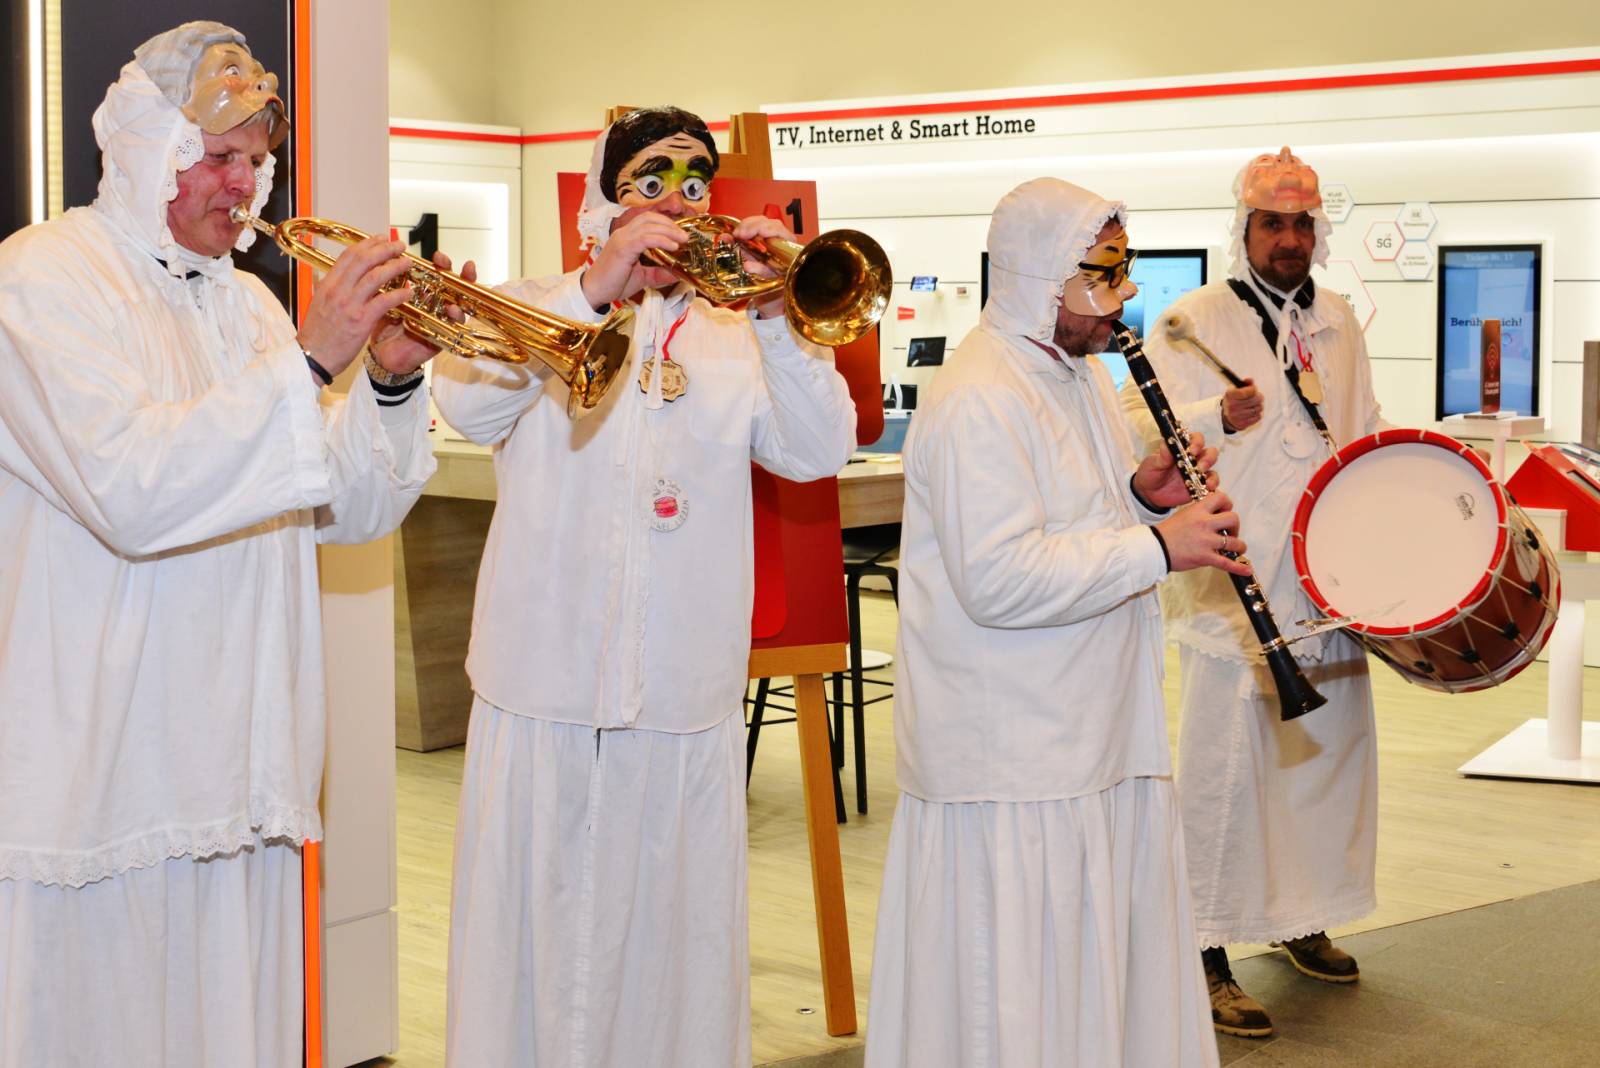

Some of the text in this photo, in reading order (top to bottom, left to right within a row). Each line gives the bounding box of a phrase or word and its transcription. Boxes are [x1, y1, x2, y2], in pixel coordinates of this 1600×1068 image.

[775, 115, 1036, 149] TV, Internet & Smart Home
